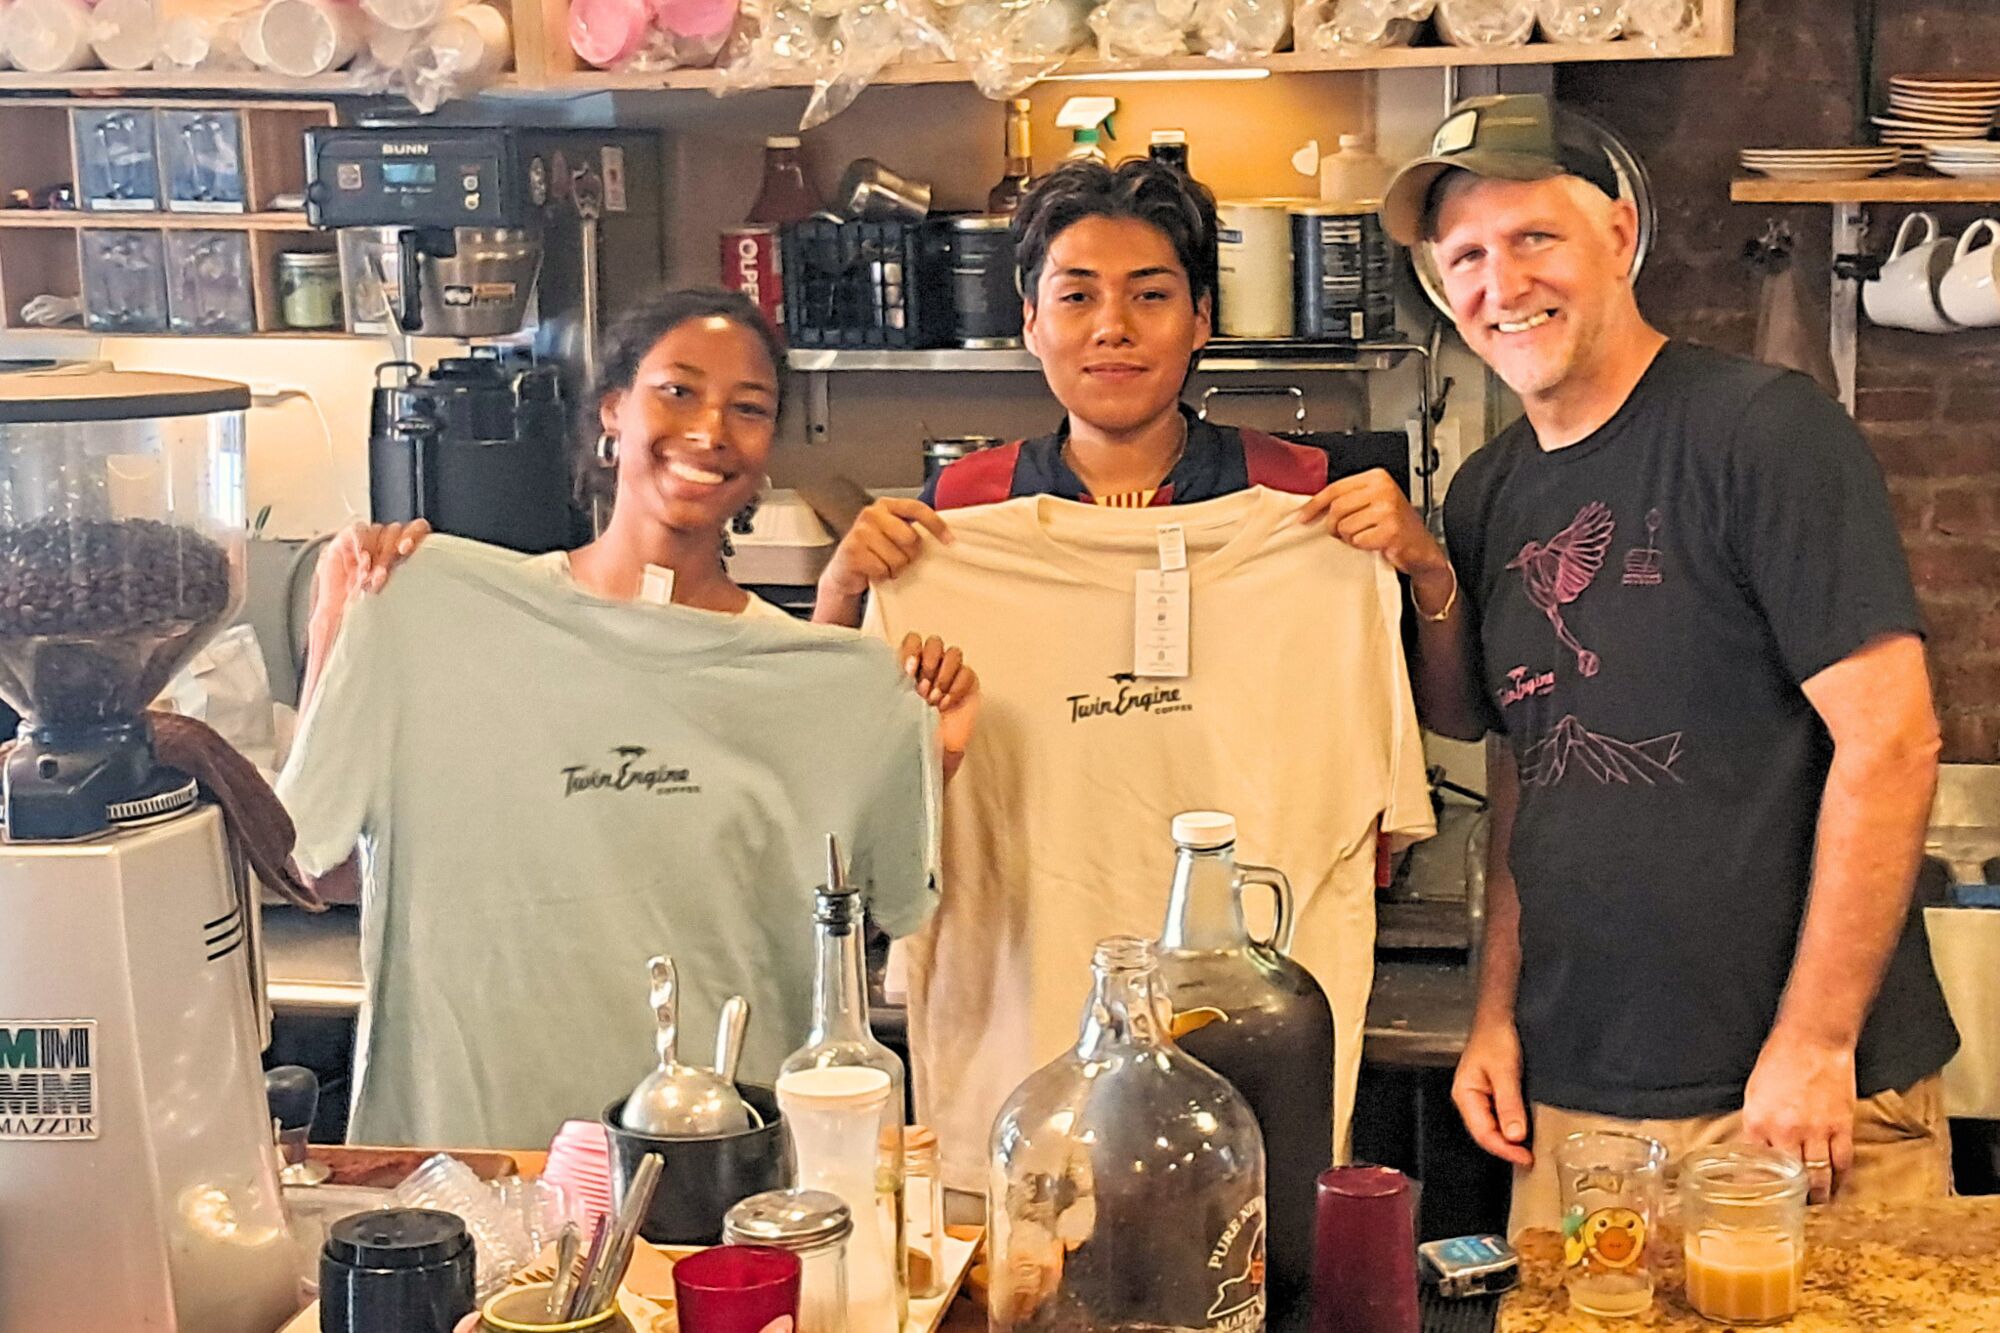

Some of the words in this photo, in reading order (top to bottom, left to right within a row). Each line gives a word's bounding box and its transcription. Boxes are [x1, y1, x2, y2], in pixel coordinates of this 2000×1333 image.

[382, 144, 429, 155] BUNN
[1154, 704, 1193, 715] COFFEE
[1208, 1218, 1241, 1269] PURE
